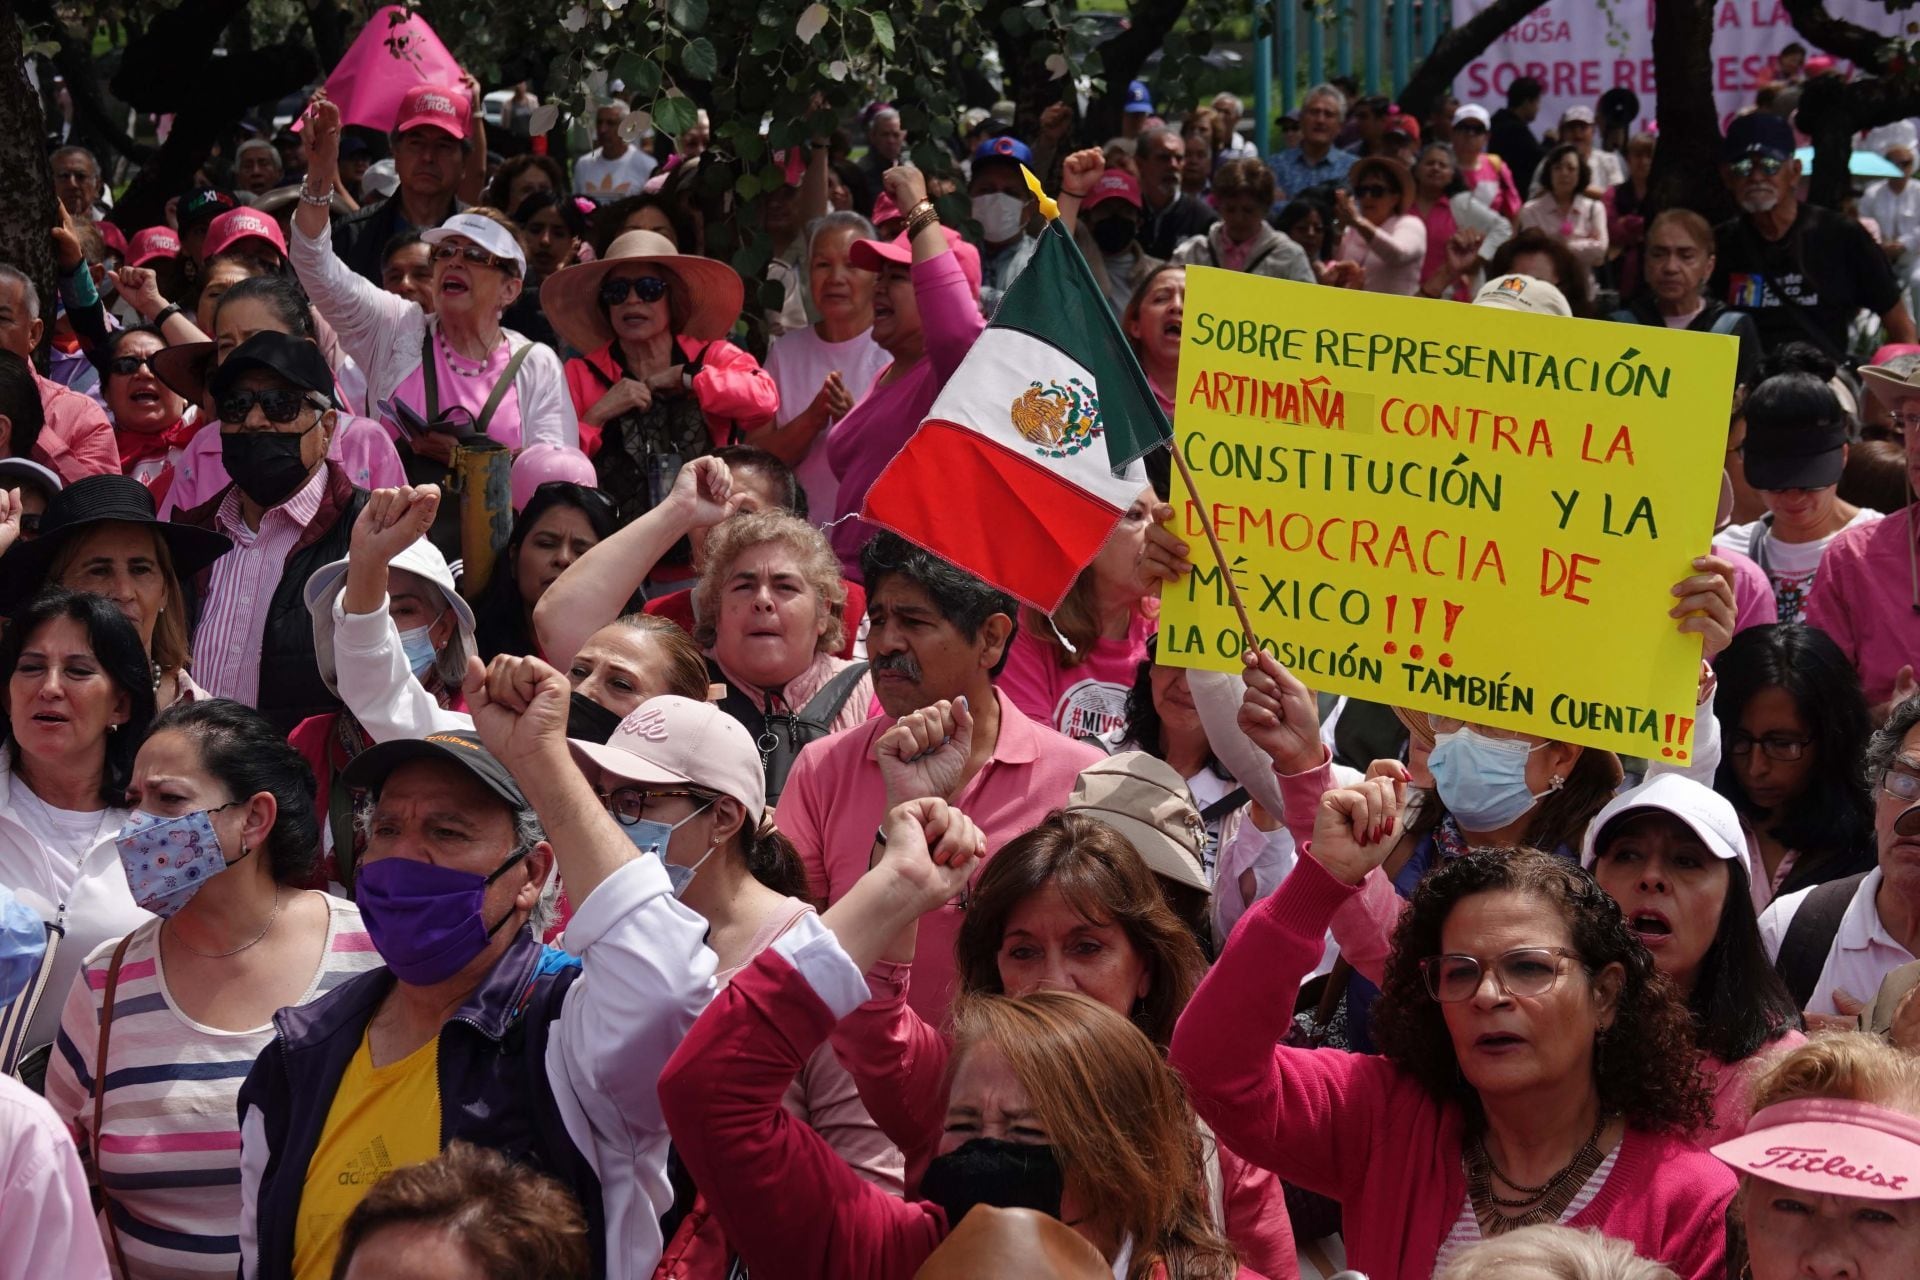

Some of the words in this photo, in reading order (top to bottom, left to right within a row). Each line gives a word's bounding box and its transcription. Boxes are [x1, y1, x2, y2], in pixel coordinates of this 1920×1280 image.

[995, 138, 1012, 155] C
[1191, 313, 1307, 361] SOBRE
[1315, 328, 1671, 399] REPRESENTACIÓN
[1189, 370, 1345, 430] ARTIMAÑA
[1380, 397, 1553, 458] CONTRA
[1581, 423, 1635, 466] LA
[1184, 431, 1502, 512] CONSTITUCIÓN
[1551, 489, 1580, 529] Y
[1602, 493, 1658, 539] LA
[1185, 500, 1507, 586] DEMOCRACIA
[1540, 547, 1601, 605] DE
[1168, 624, 1205, 655] LA
[1401, 663, 1534, 715] TAMBIÉN
[1749, 1147, 1908, 1190] Titleist
